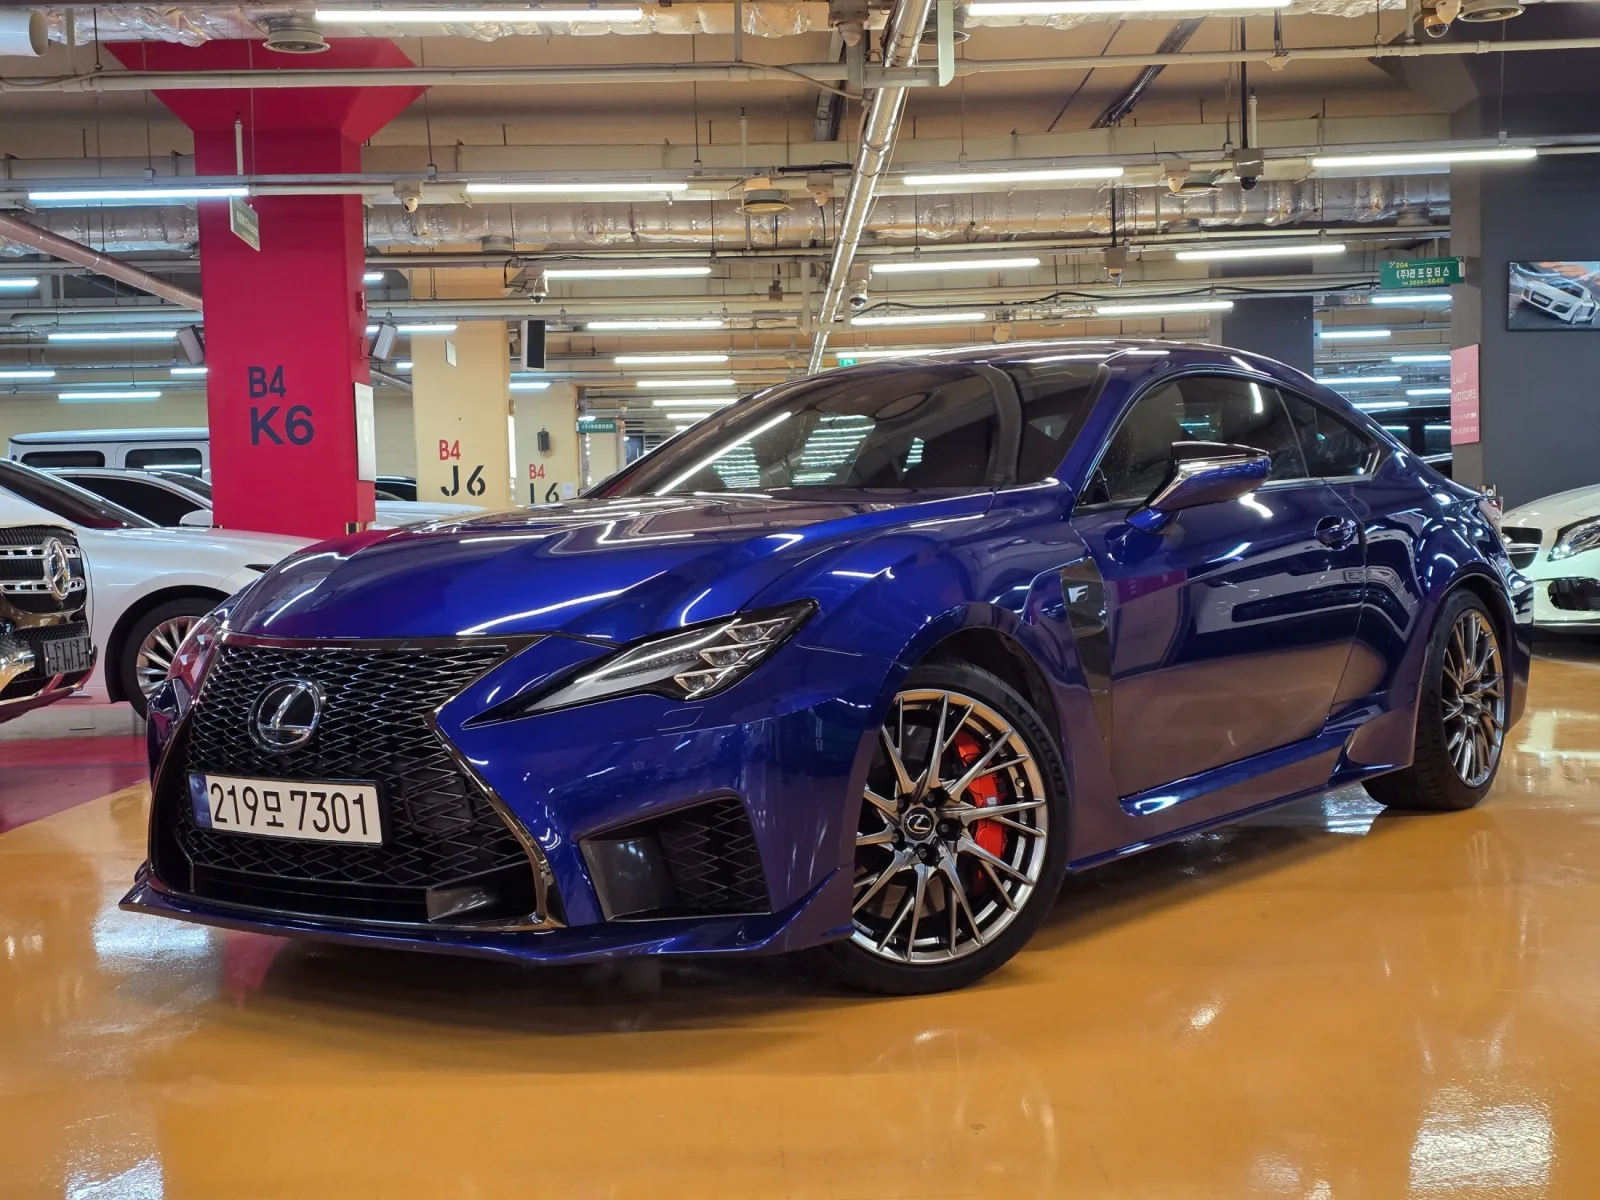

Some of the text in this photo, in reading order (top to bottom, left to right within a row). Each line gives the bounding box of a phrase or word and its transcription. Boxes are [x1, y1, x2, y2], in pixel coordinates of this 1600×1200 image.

[248, 365, 286, 398] B4
[1452, 389, 1477, 403] MOTORS
[250, 404, 315, 446] K6
[439, 439, 461, 461] B4
[529, 463, 545, 479] B4
